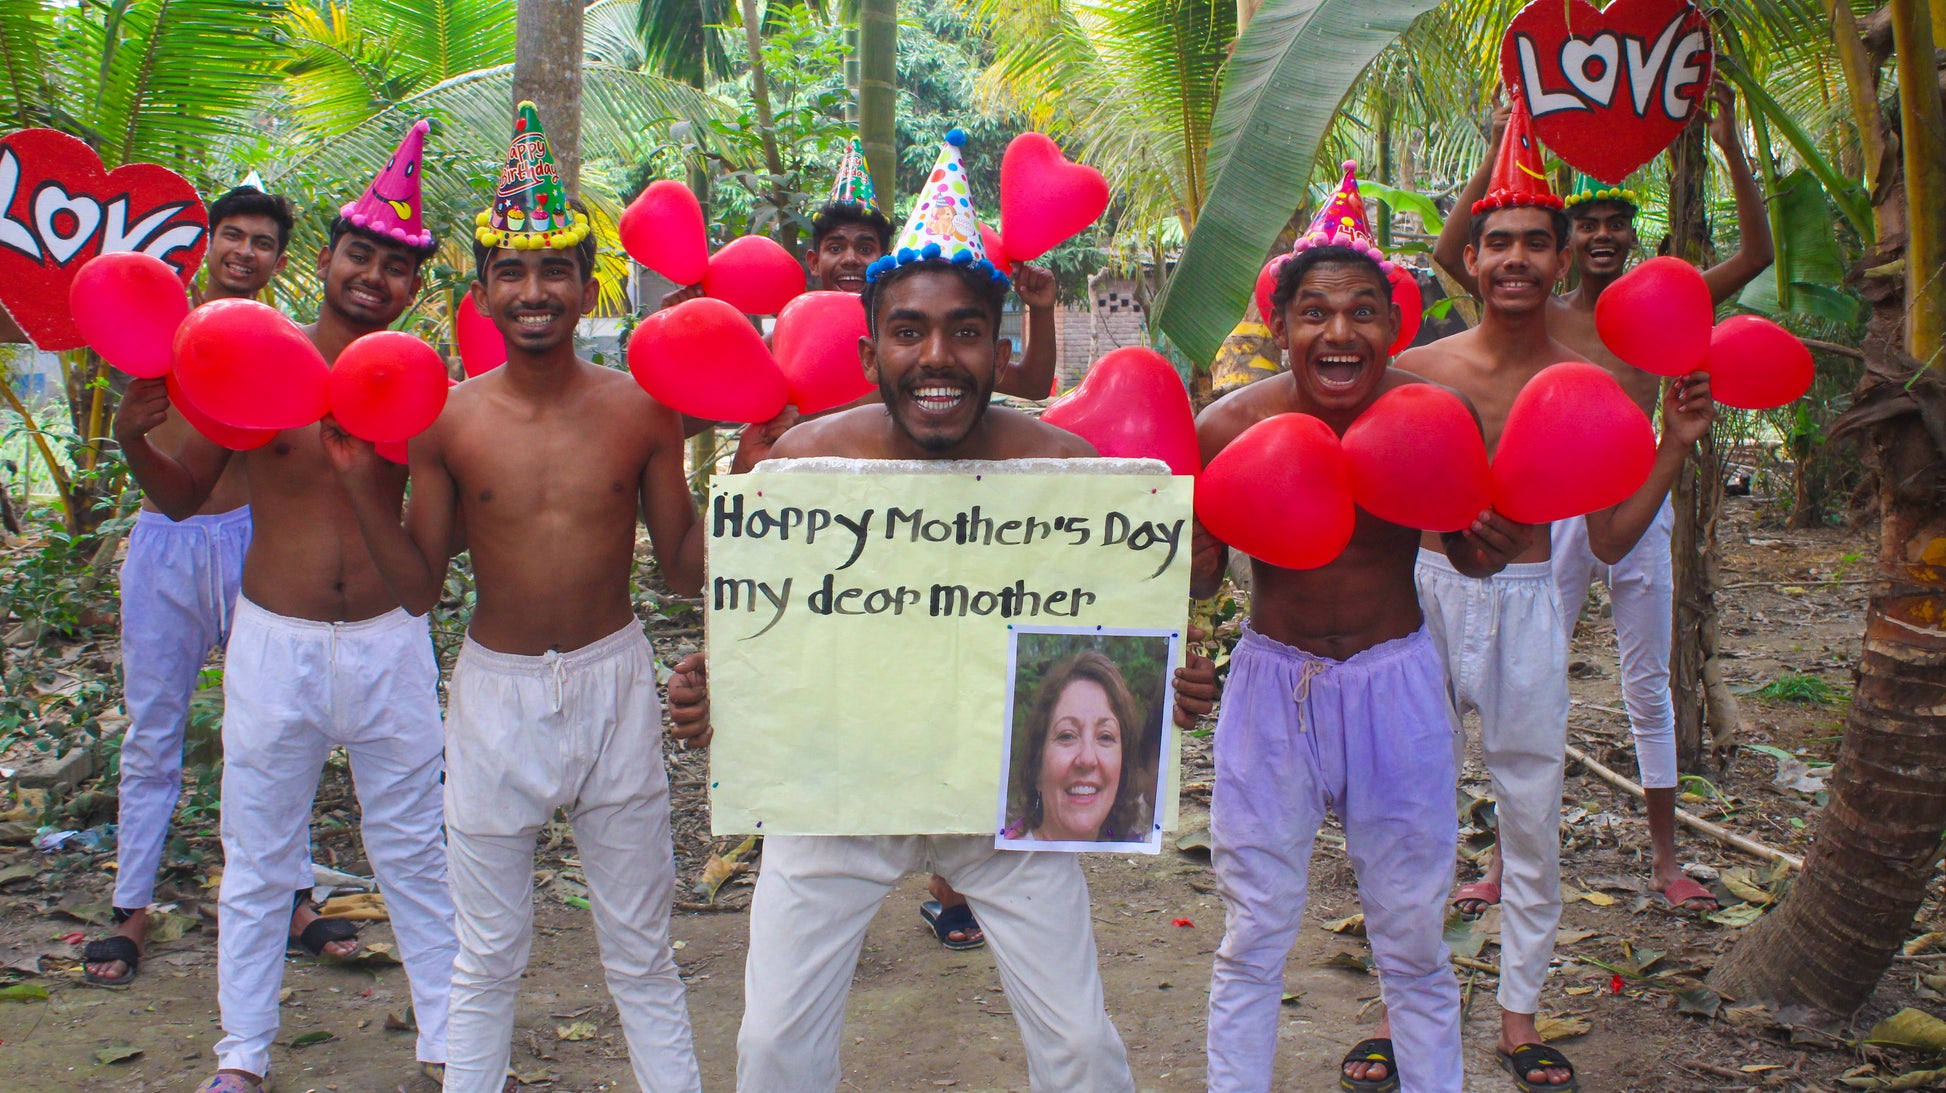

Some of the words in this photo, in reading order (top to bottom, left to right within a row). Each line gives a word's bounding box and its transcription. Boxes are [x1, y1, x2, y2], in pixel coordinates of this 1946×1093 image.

[1514, 5, 1706, 121] LOVE
[508, 140, 546, 163] appy
[713, 493, 874, 570] Happy
[885, 505, 1091, 545] Mother's
[1100, 511, 1186, 582] Day
[714, 576, 793, 641] my
[808, 573, 920, 615] dear
[930, 580, 1097, 618] mother
